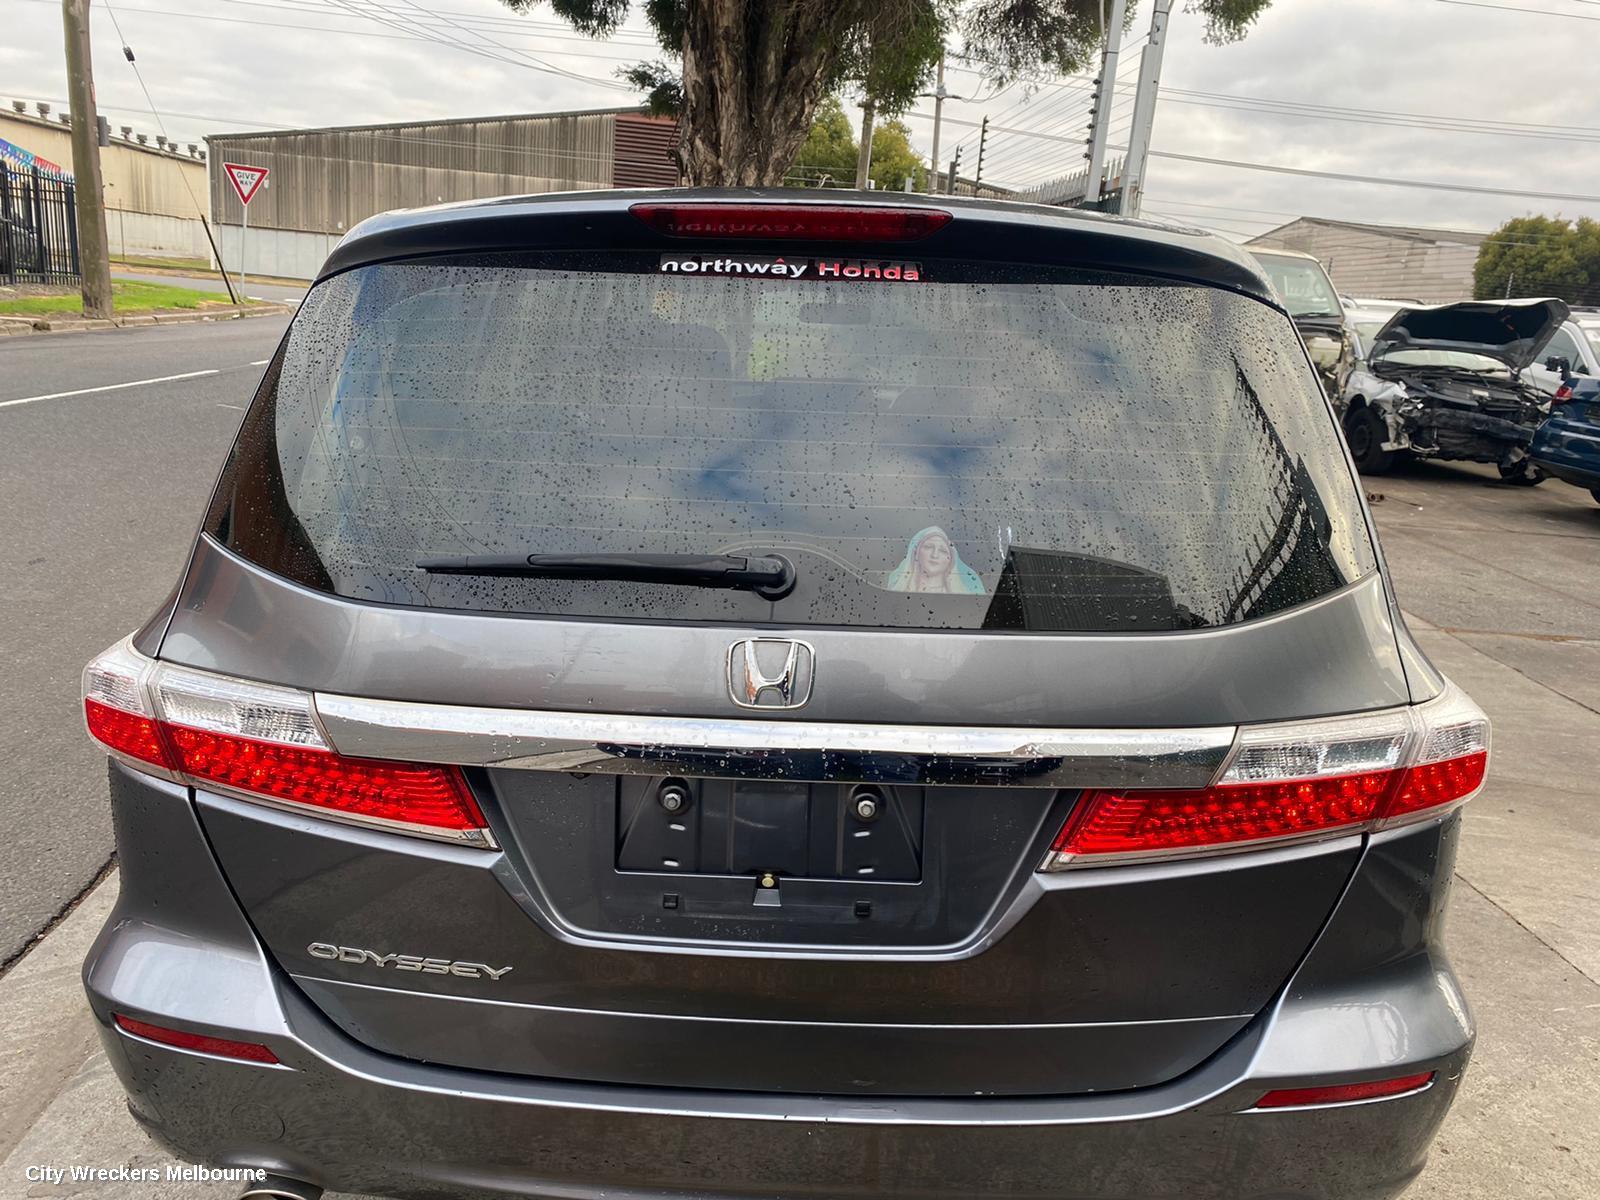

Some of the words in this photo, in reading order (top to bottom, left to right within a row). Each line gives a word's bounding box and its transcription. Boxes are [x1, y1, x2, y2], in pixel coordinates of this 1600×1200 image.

[237, 172, 256, 180] GIVE
[818, 261, 920, 281] Honda
[307, 942, 513, 981] ODYSSEY
